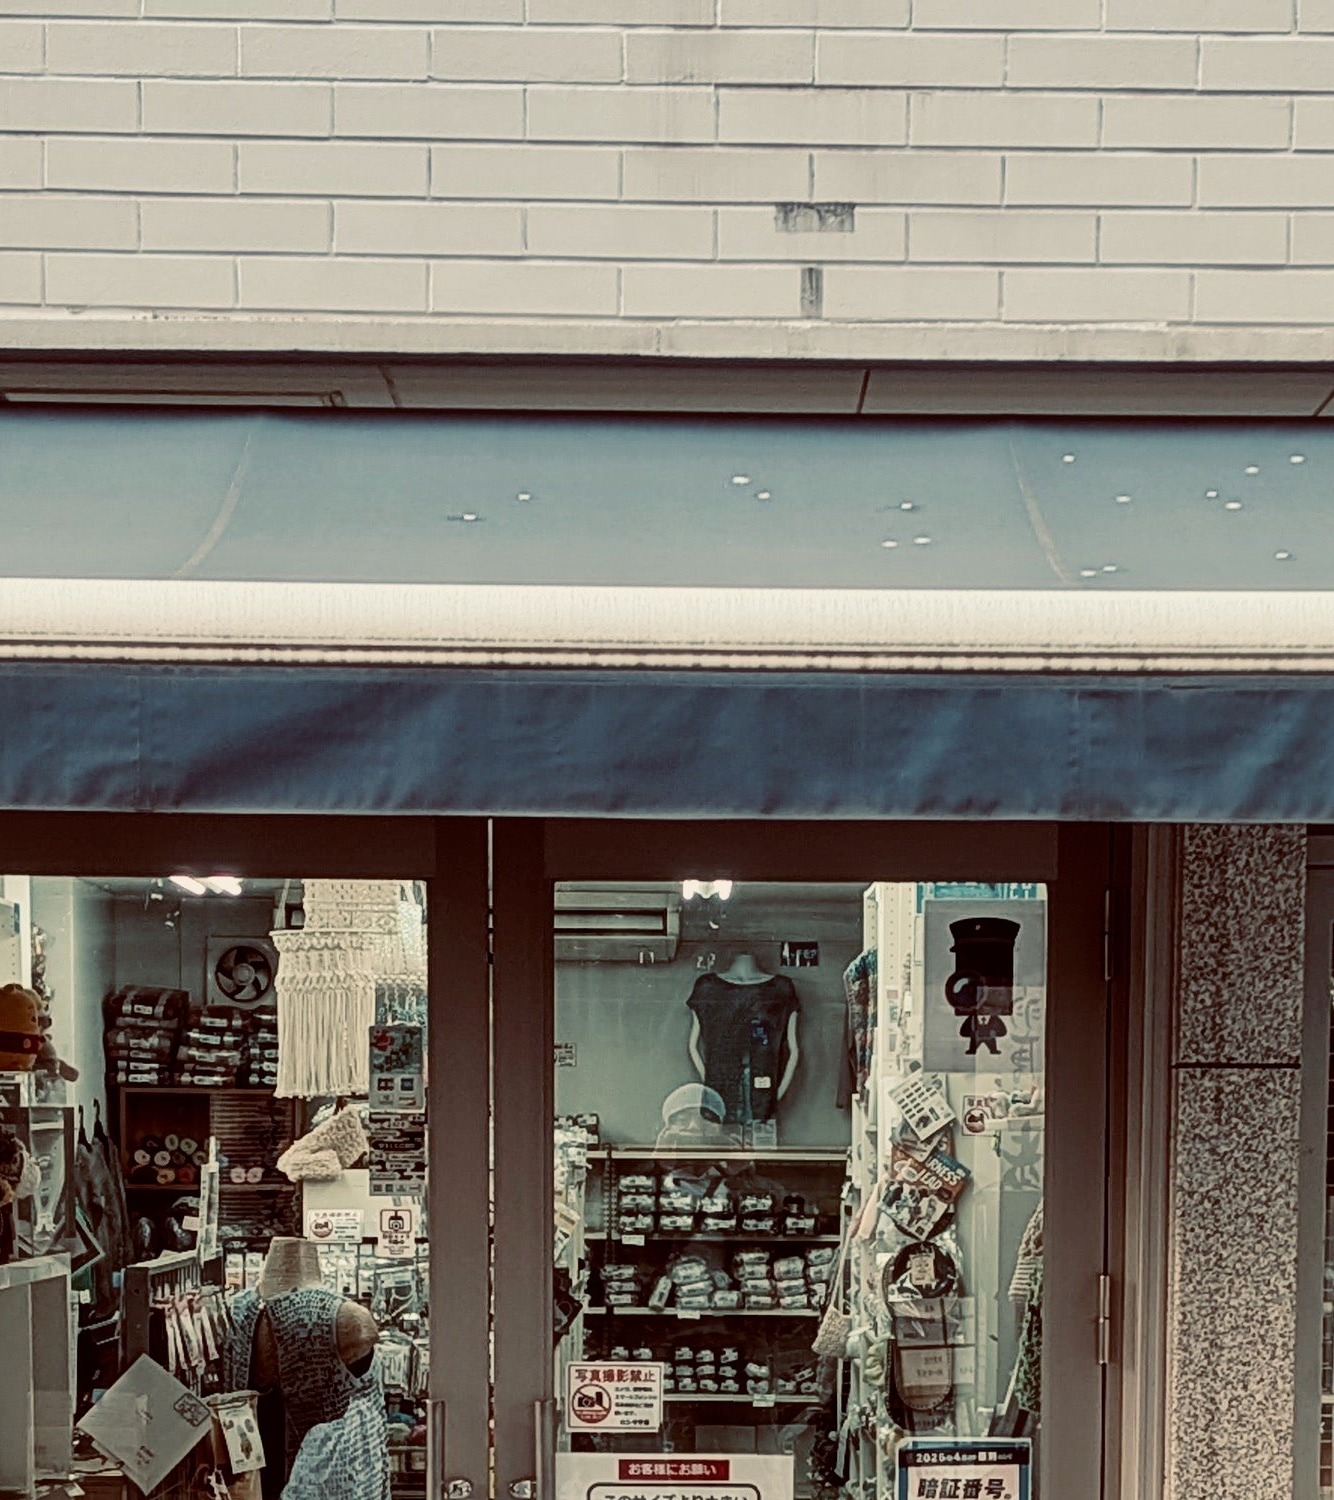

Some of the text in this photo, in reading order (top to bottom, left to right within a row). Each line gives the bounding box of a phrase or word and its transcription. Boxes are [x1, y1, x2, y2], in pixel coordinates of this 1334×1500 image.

[574, 1368, 656, 1383] 写真撮影禁止
[628, 1463, 717, 1476] お客様にお願い
